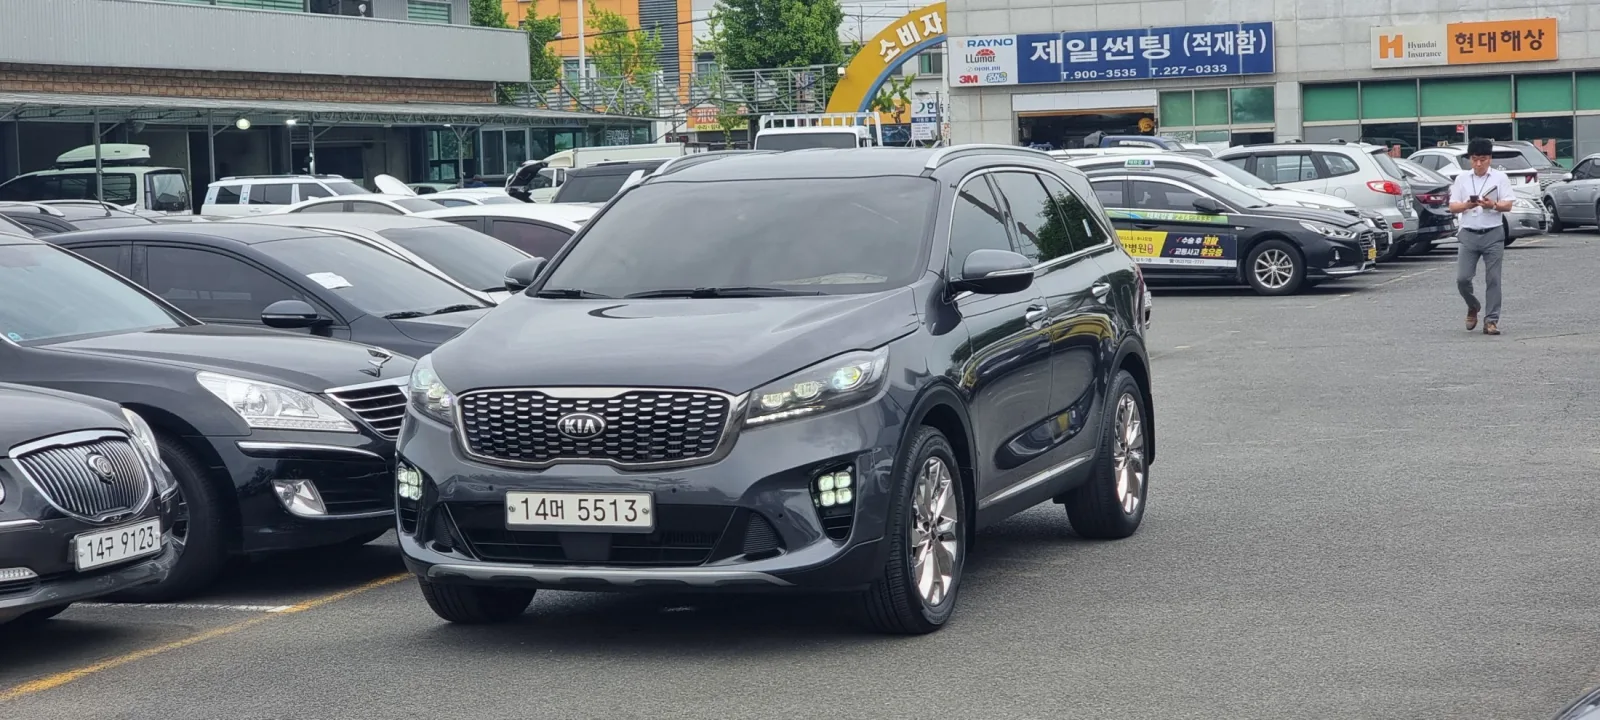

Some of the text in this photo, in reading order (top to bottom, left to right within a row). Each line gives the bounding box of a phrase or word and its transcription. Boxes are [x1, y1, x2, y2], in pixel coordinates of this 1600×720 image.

[879, 11, 944, 63] 소비자
[967, 38, 1013, 48] RAYNO
[1454, 29, 1545, 54] 현대해상
[1030, 28, 1268, 64] 제일썬팅 (적재함)
[1407, 41, 1437, 51] Hyundai
[1407, 50, 1442, 58] Insurance
[959, 75, 979, 84] 3M
[1061, 64, 1228, 80] T.900-3535 T.227-0333
[1180, 236, 1195, 245] 수술
[1174, 247, 1200, 256] 교통사고
[564, 418, 597, 434] KIA
[520, 497, 638, 522] 14머 5513
[87, 525, 154, 562] 14구 9123
